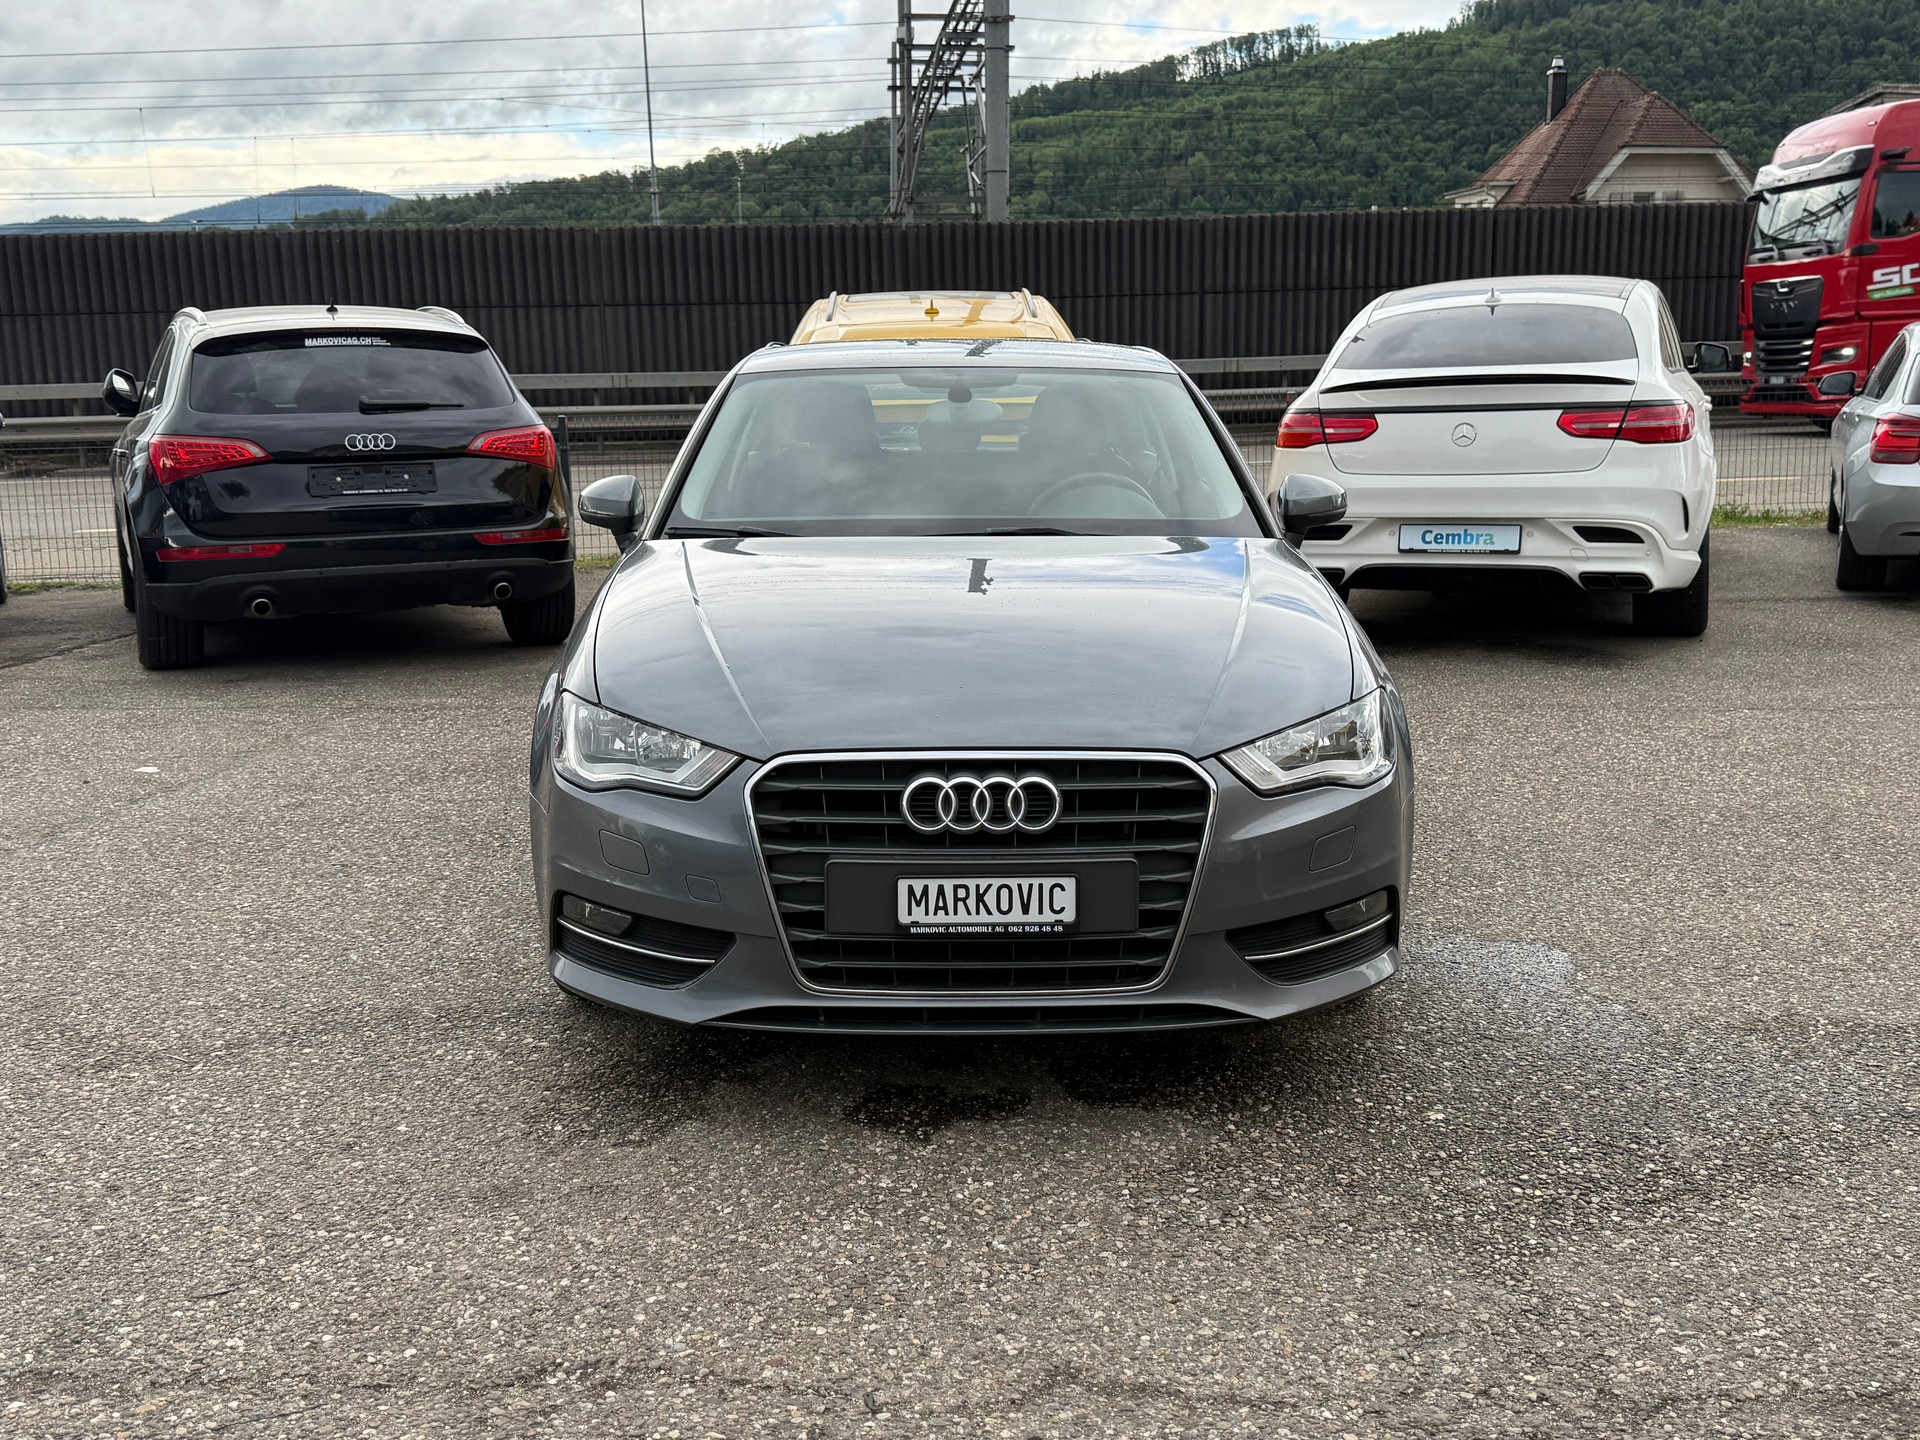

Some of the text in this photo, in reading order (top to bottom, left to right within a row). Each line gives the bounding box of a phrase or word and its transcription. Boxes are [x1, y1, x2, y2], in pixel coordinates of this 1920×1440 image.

[304, 336, 372, 347] MARKOVICAG.CH
[1421, 528, 1495, 546] Cembra
[907, 882, 1066, 917] MARKOVIC
[910, 925, 1063, 934] MARKOVIC AUTOMOBILE AG 062 926 48 48
